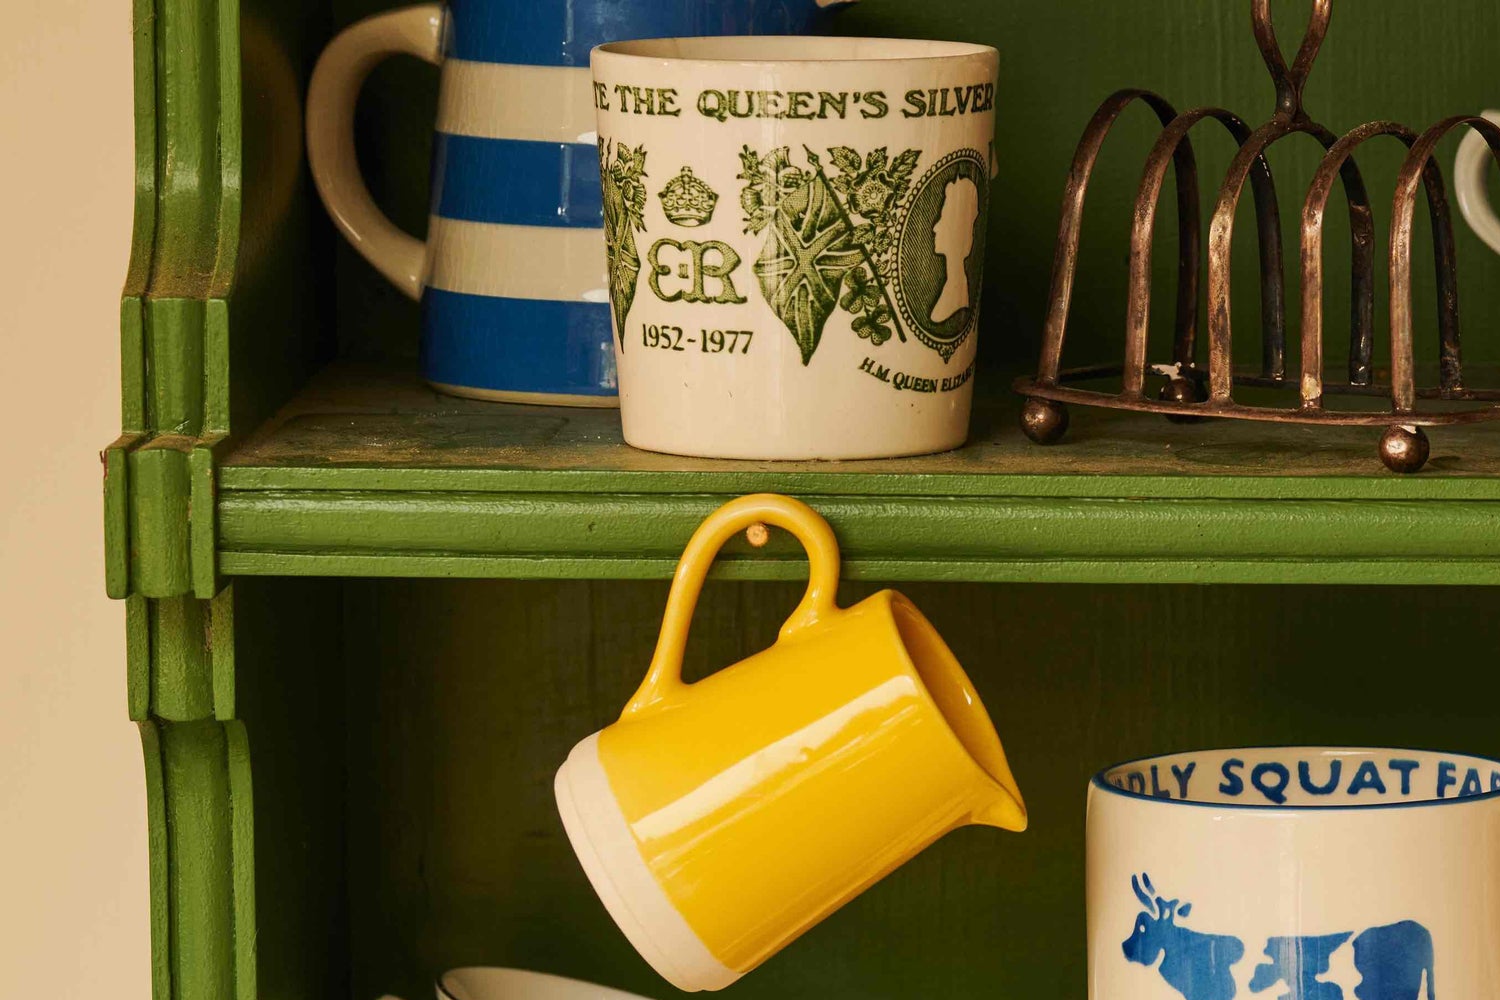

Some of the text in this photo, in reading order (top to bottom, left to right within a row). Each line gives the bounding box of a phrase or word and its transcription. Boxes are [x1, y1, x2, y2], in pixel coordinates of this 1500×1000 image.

[614, 84, 681, 117] THE
[697, 88, 889, 122] QUEEN'S
[901, 82, 994, 118] SILVER
[642, 323, 754, 355] 1952-1977
[858, 357, 890, 382] H.M.
[893, 372, 938, 393] QUEEN
[1219, 758, 1420, 804] SQUAT
